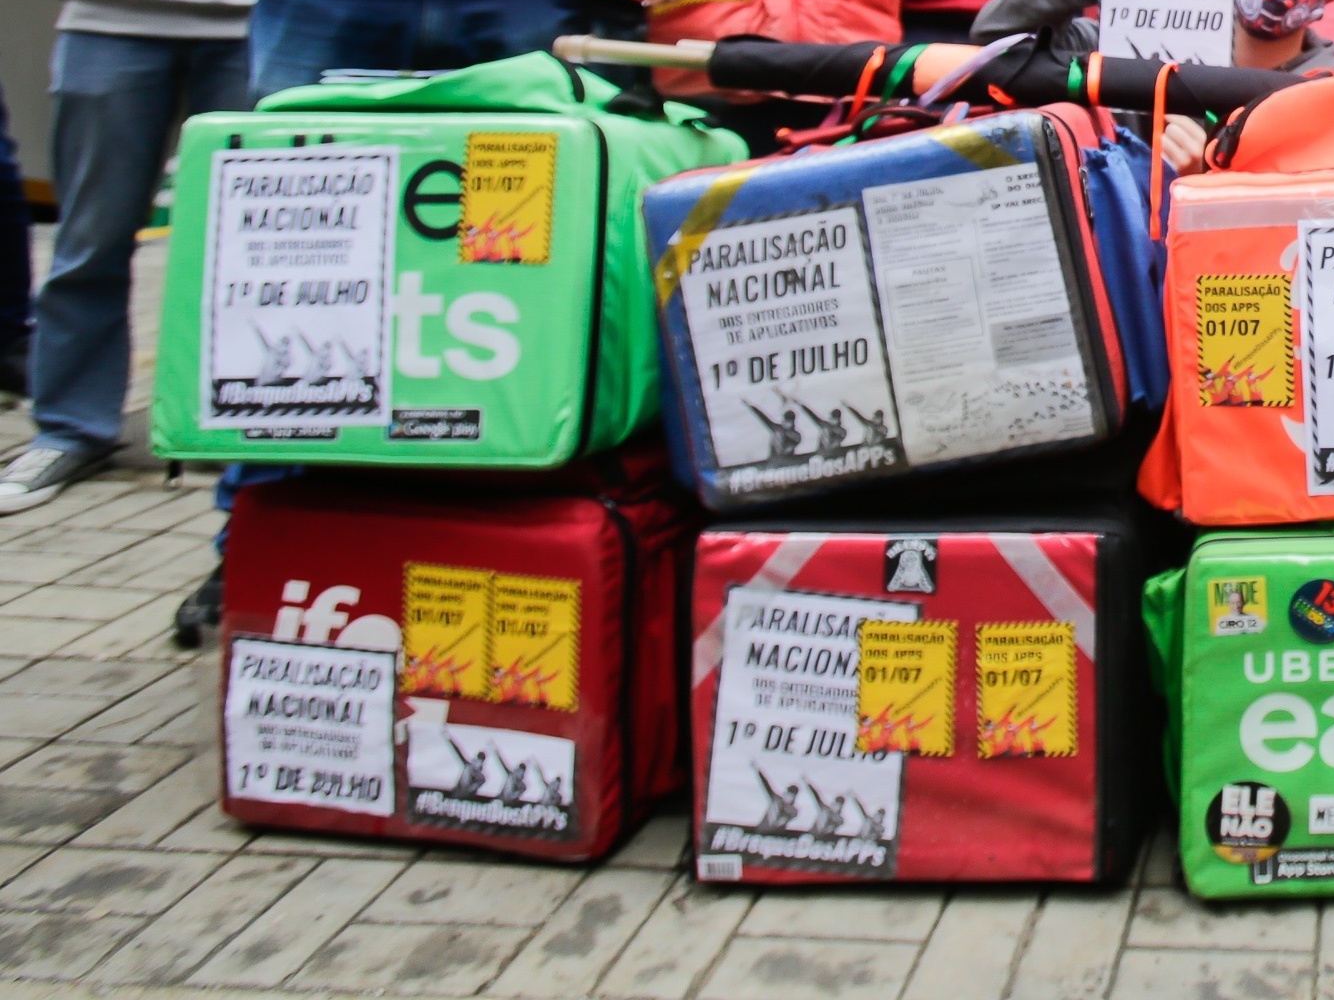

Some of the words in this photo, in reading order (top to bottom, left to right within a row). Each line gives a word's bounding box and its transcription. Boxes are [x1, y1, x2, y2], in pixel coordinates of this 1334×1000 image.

[1135, 8, 1158, 29] DE
[1163, 9, 1223, 31] JULHO
[471, 176, 526, 193] 01/07
[237, 204, 359, 233] NACIONAL
[687, 220, 847, 275] PARALISAÇÃO
[259, 282, 297, 306] DE
[300, 279, 369, 307] JULHO
[707, 261, 841, 309] NACIONAL
[1205, 283, 1281, 298] PARALISAÇÃO
[746, 298, 839, 324] ENTREGADORES
[1205, 302, 1228, 313] DOS
[1232, 302, 1260, 313] APPS
[748, 314, 838, 342] APLICATIVOS
[1206, 319, 1260, 336] 01/07
[749, 351, 780, 384] DE
[788, 338, 869, 379] JULHO
[728, 445, 897, 494] #BrequeDosAPPs
[866, 632, 945, 645] PARALISAÇÃO
[985, 634, 1064, 646] PARALISAÇÃO
[865, 667, 922, 684] 01/07
[986, 669, 1043, 687] 01/07
[765, 725, 799, 751] DE
[275, 763, 307, 792] DE
[1221, 784, 1277, 817] ELE
[1220, 814, 1273, 838] NÃO
[1277, 864, 1305, 878] App
